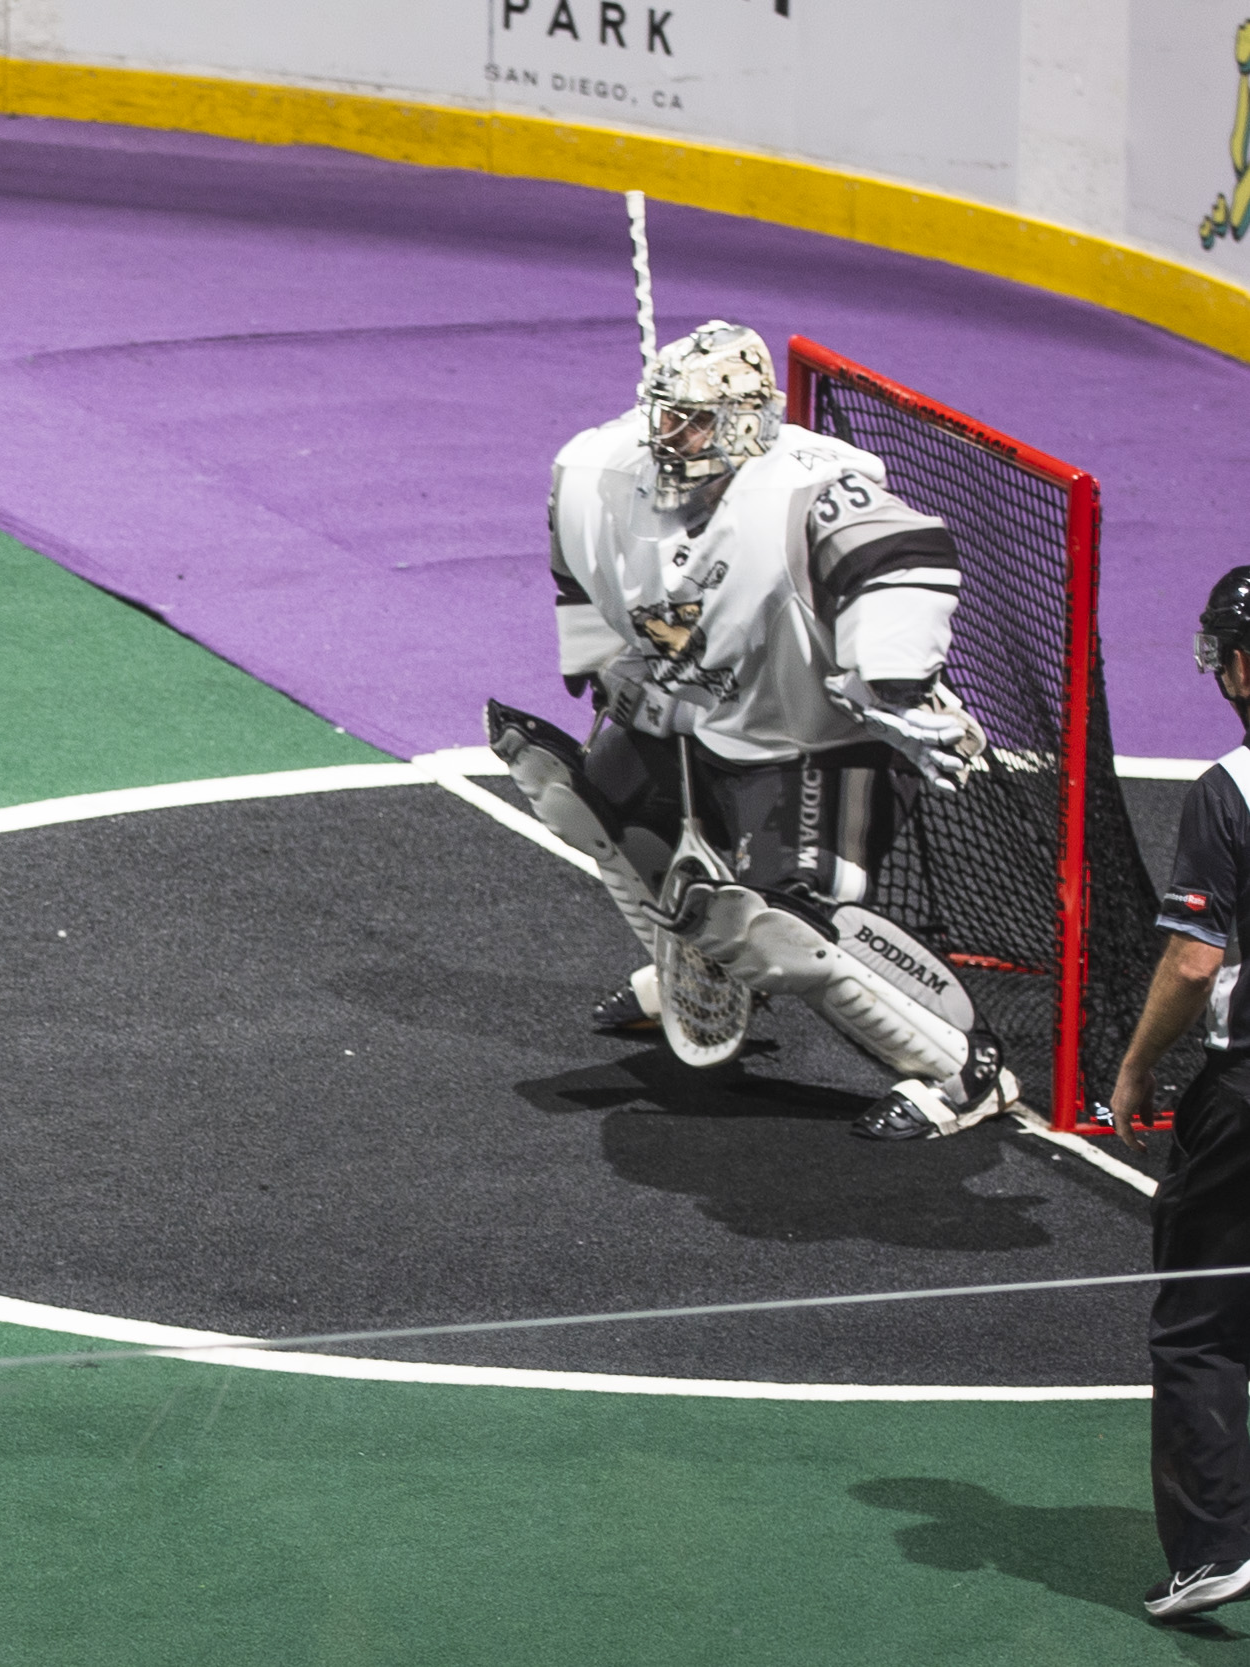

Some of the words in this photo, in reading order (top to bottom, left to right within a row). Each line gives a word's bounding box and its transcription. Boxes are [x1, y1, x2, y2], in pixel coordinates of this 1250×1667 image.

[503, 0, 672, 56] PARK
[484, 62, 539, 86] SAN
[551, 73, 638, 106] DIEGO,
[652, 90, 684, 110] CA
[797, 752, 823, 870] ODDAM
[854, 925, 949, 996] BODDAM
[974, 1046, 998, 1080] 35
